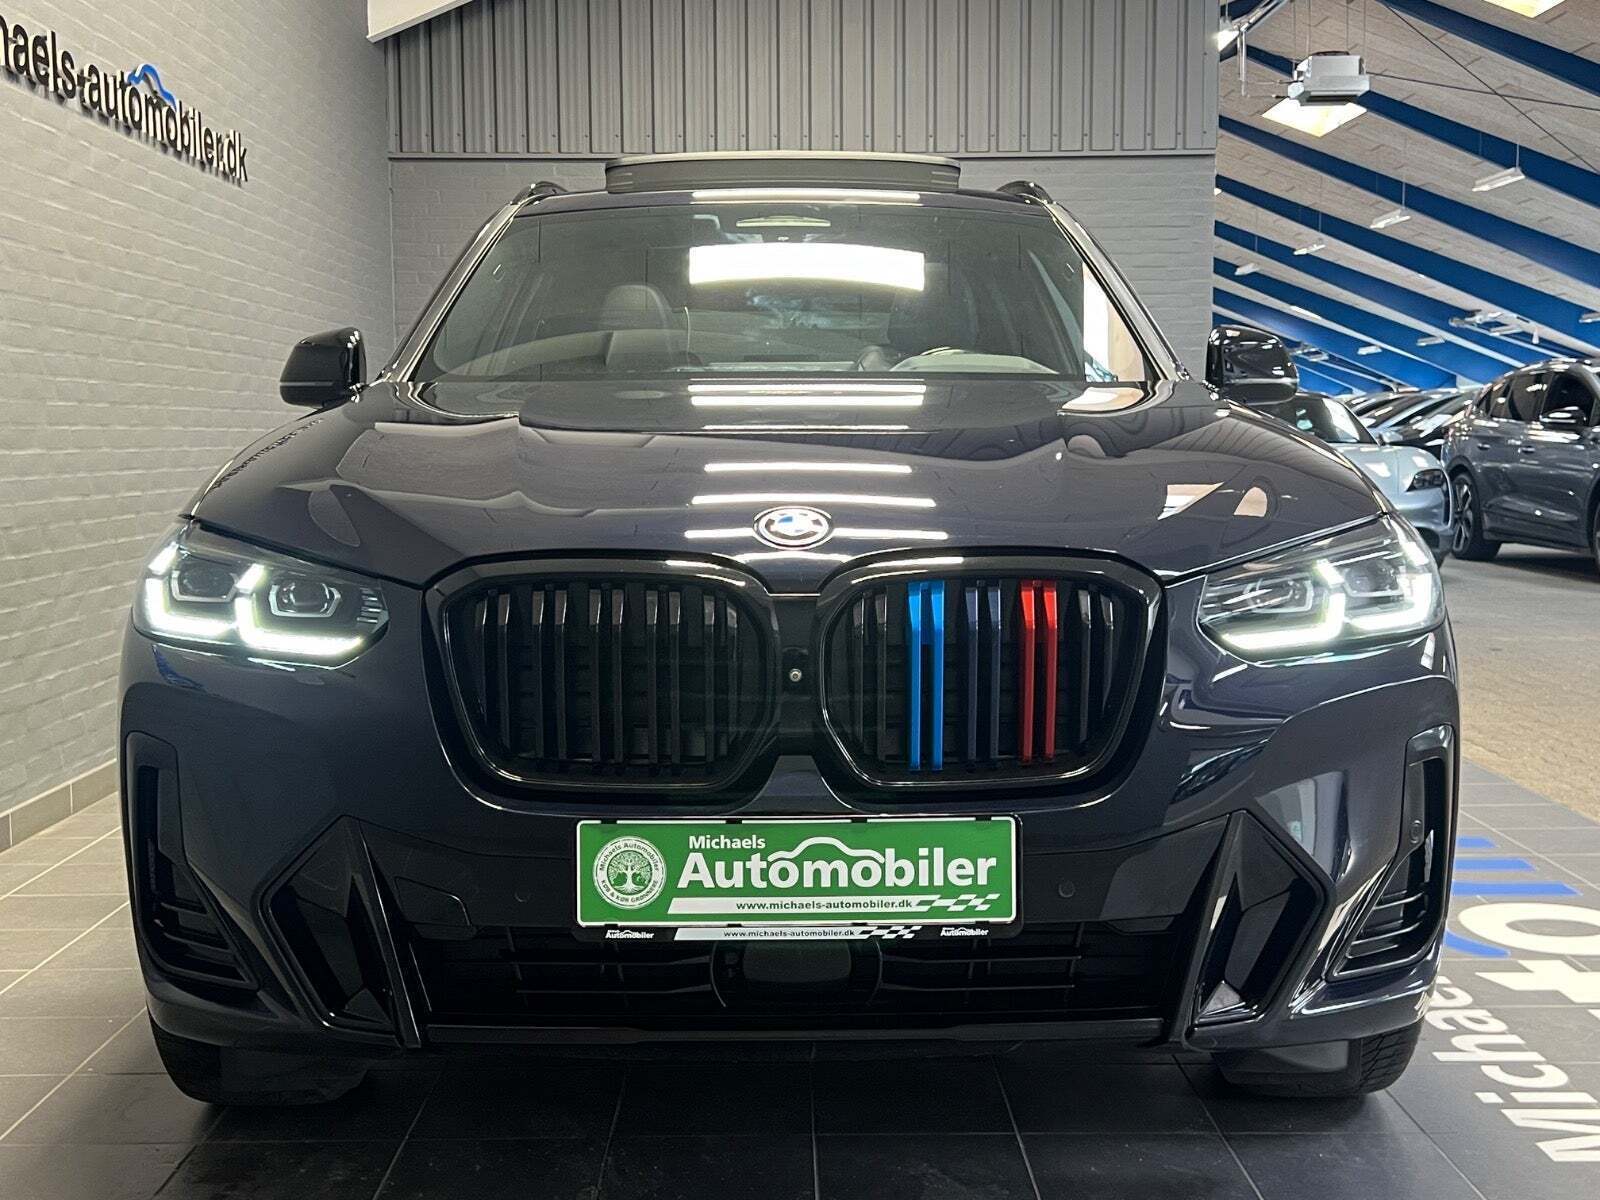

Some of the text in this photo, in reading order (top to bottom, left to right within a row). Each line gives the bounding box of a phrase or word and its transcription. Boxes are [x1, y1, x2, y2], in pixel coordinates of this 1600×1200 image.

[689, 835, 766, 849] Michaels
[677, 847, 997, 889] Automobiler
[736, 900, 912, 910] www.michaels-automobiler.dk
[605, 931, 654, 939] Automobiler
[940, 928, 989, 936] Automobiler
